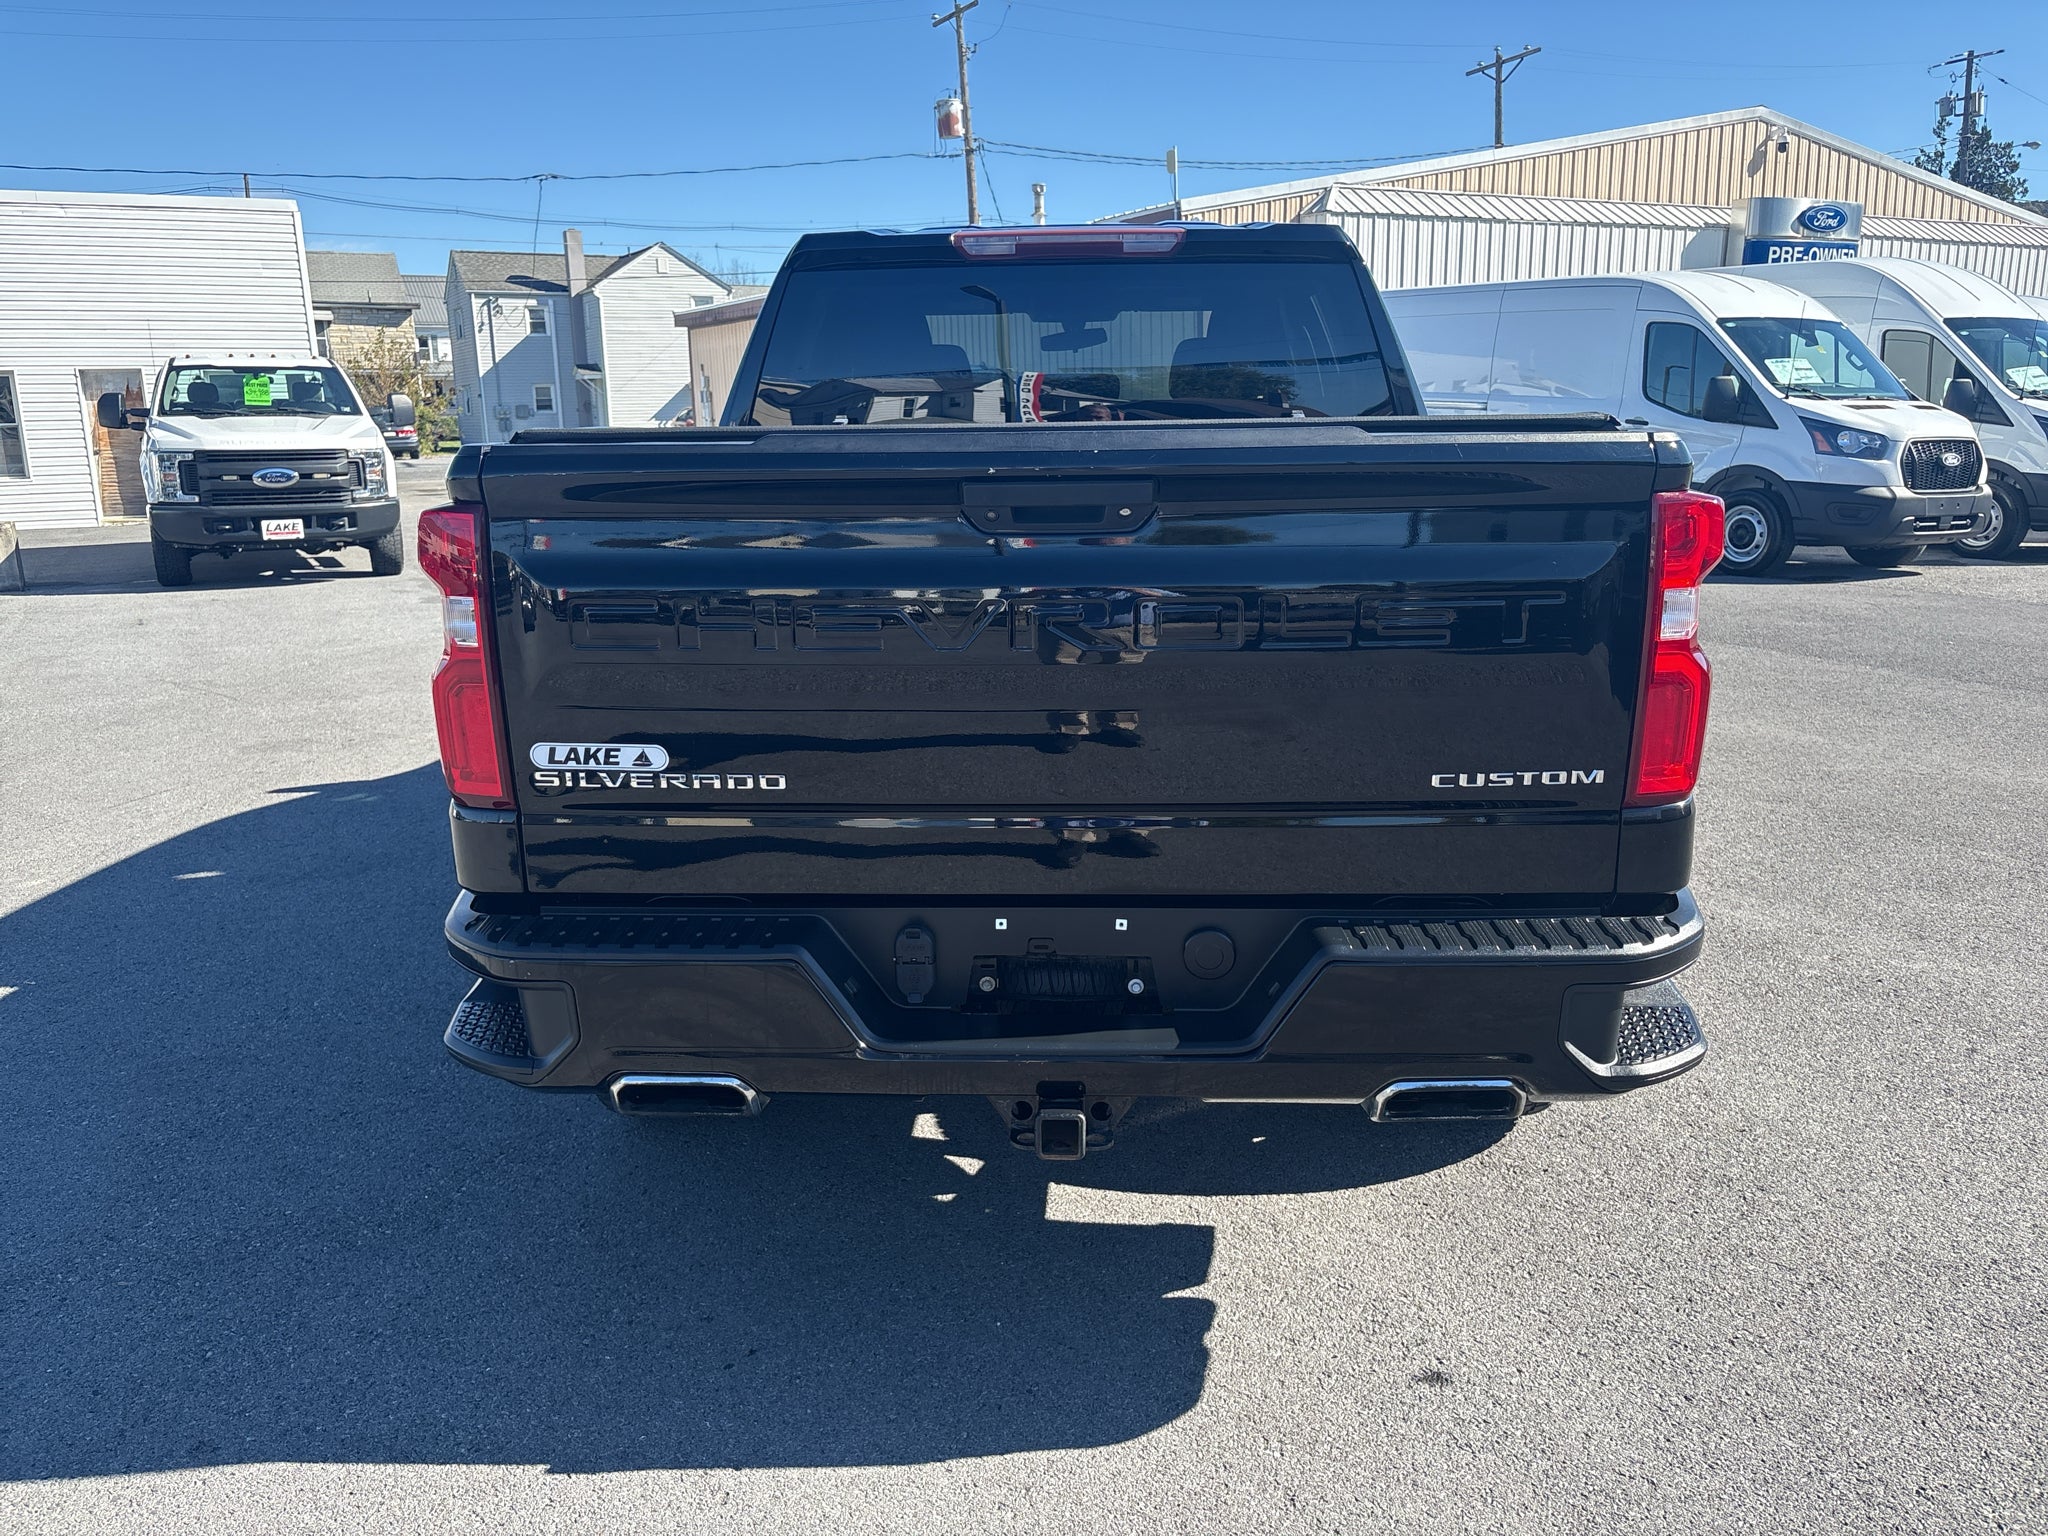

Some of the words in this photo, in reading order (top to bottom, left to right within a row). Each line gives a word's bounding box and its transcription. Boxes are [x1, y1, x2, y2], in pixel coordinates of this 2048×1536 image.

[1814, 210, 1840, 227] Ford
[265, 473, 288, 482] Ford
[266, 522, 300, 532] LAKE
[568, 593, 1567, 651] CHEVROLET
[548, 747, 621, 766] LAKE
[534, 771, 787, 789] SILVERADO
[1431, 769, 1605, 788] CUSTOM
